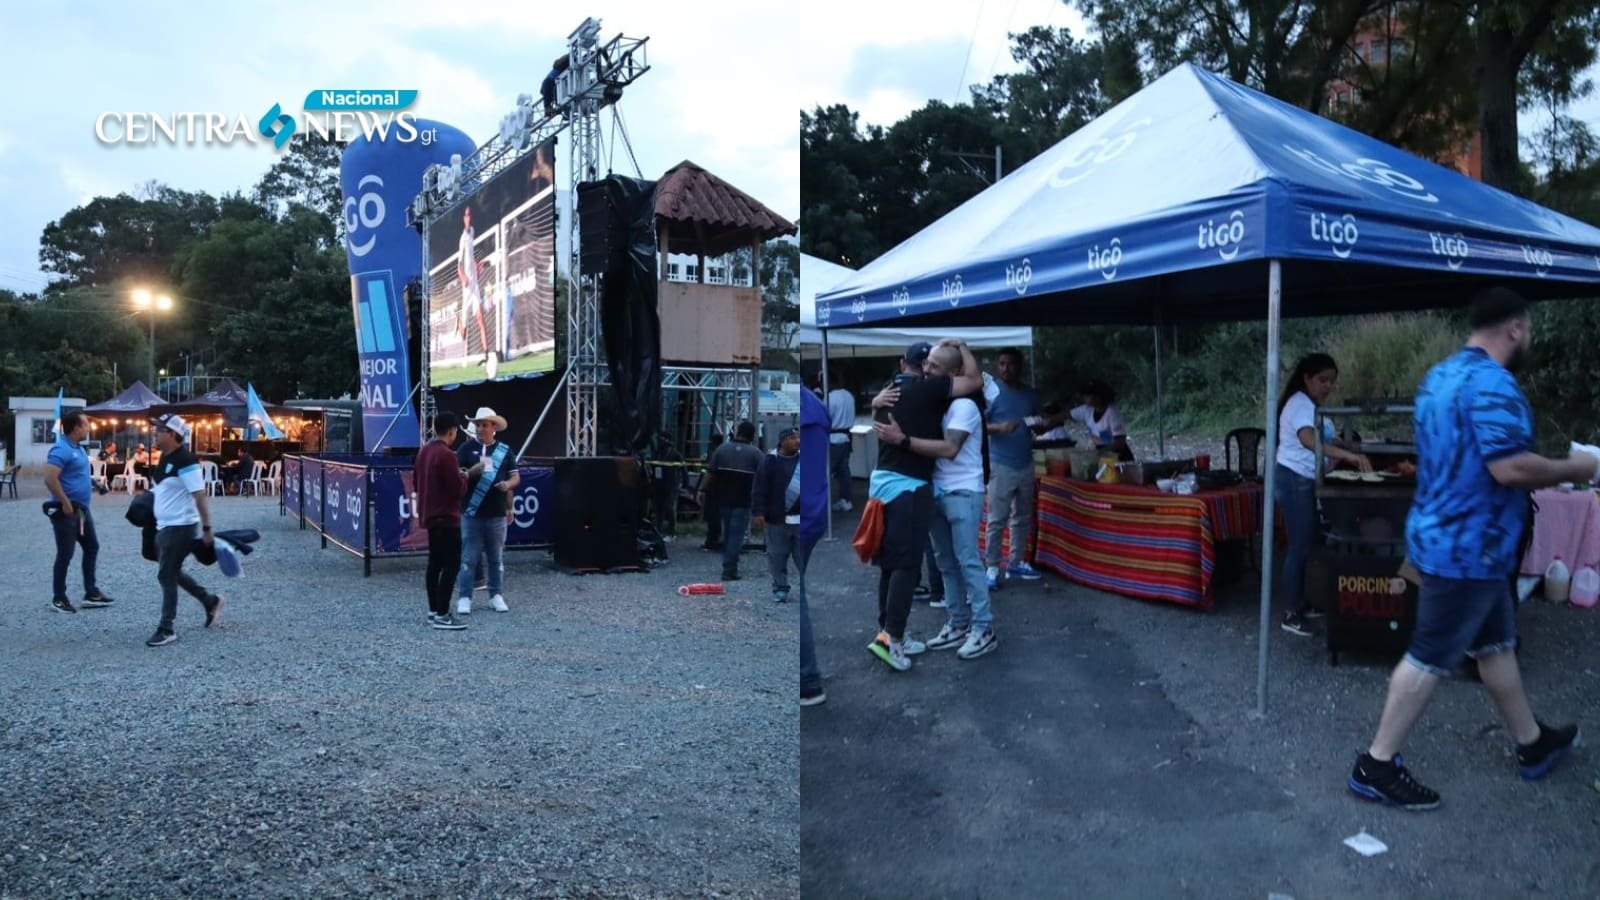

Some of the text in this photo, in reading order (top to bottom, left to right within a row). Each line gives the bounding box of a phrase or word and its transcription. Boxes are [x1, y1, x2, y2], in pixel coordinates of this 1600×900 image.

[344, 175, 386, 233] GO
[1198, 211, 1245, 250] tigo
[1309, 213, 1359, 245] tigo
[1087, 238, 1123, 271] tigo
[1429, 232, 1469, 257] tigo
[1520, 246, 1554, 267] tigo
[1005, 258, 1032, 286] tigo
[892, 286, 910, 308] tigo
[942, 275, 964, 300] tigo
[361, 379, 400, 409] ÑAL
[399, 492, 419, 519] ti
[512, 487, 540, 516] GO
[1338, 576, 1393, 594] PORCIN
